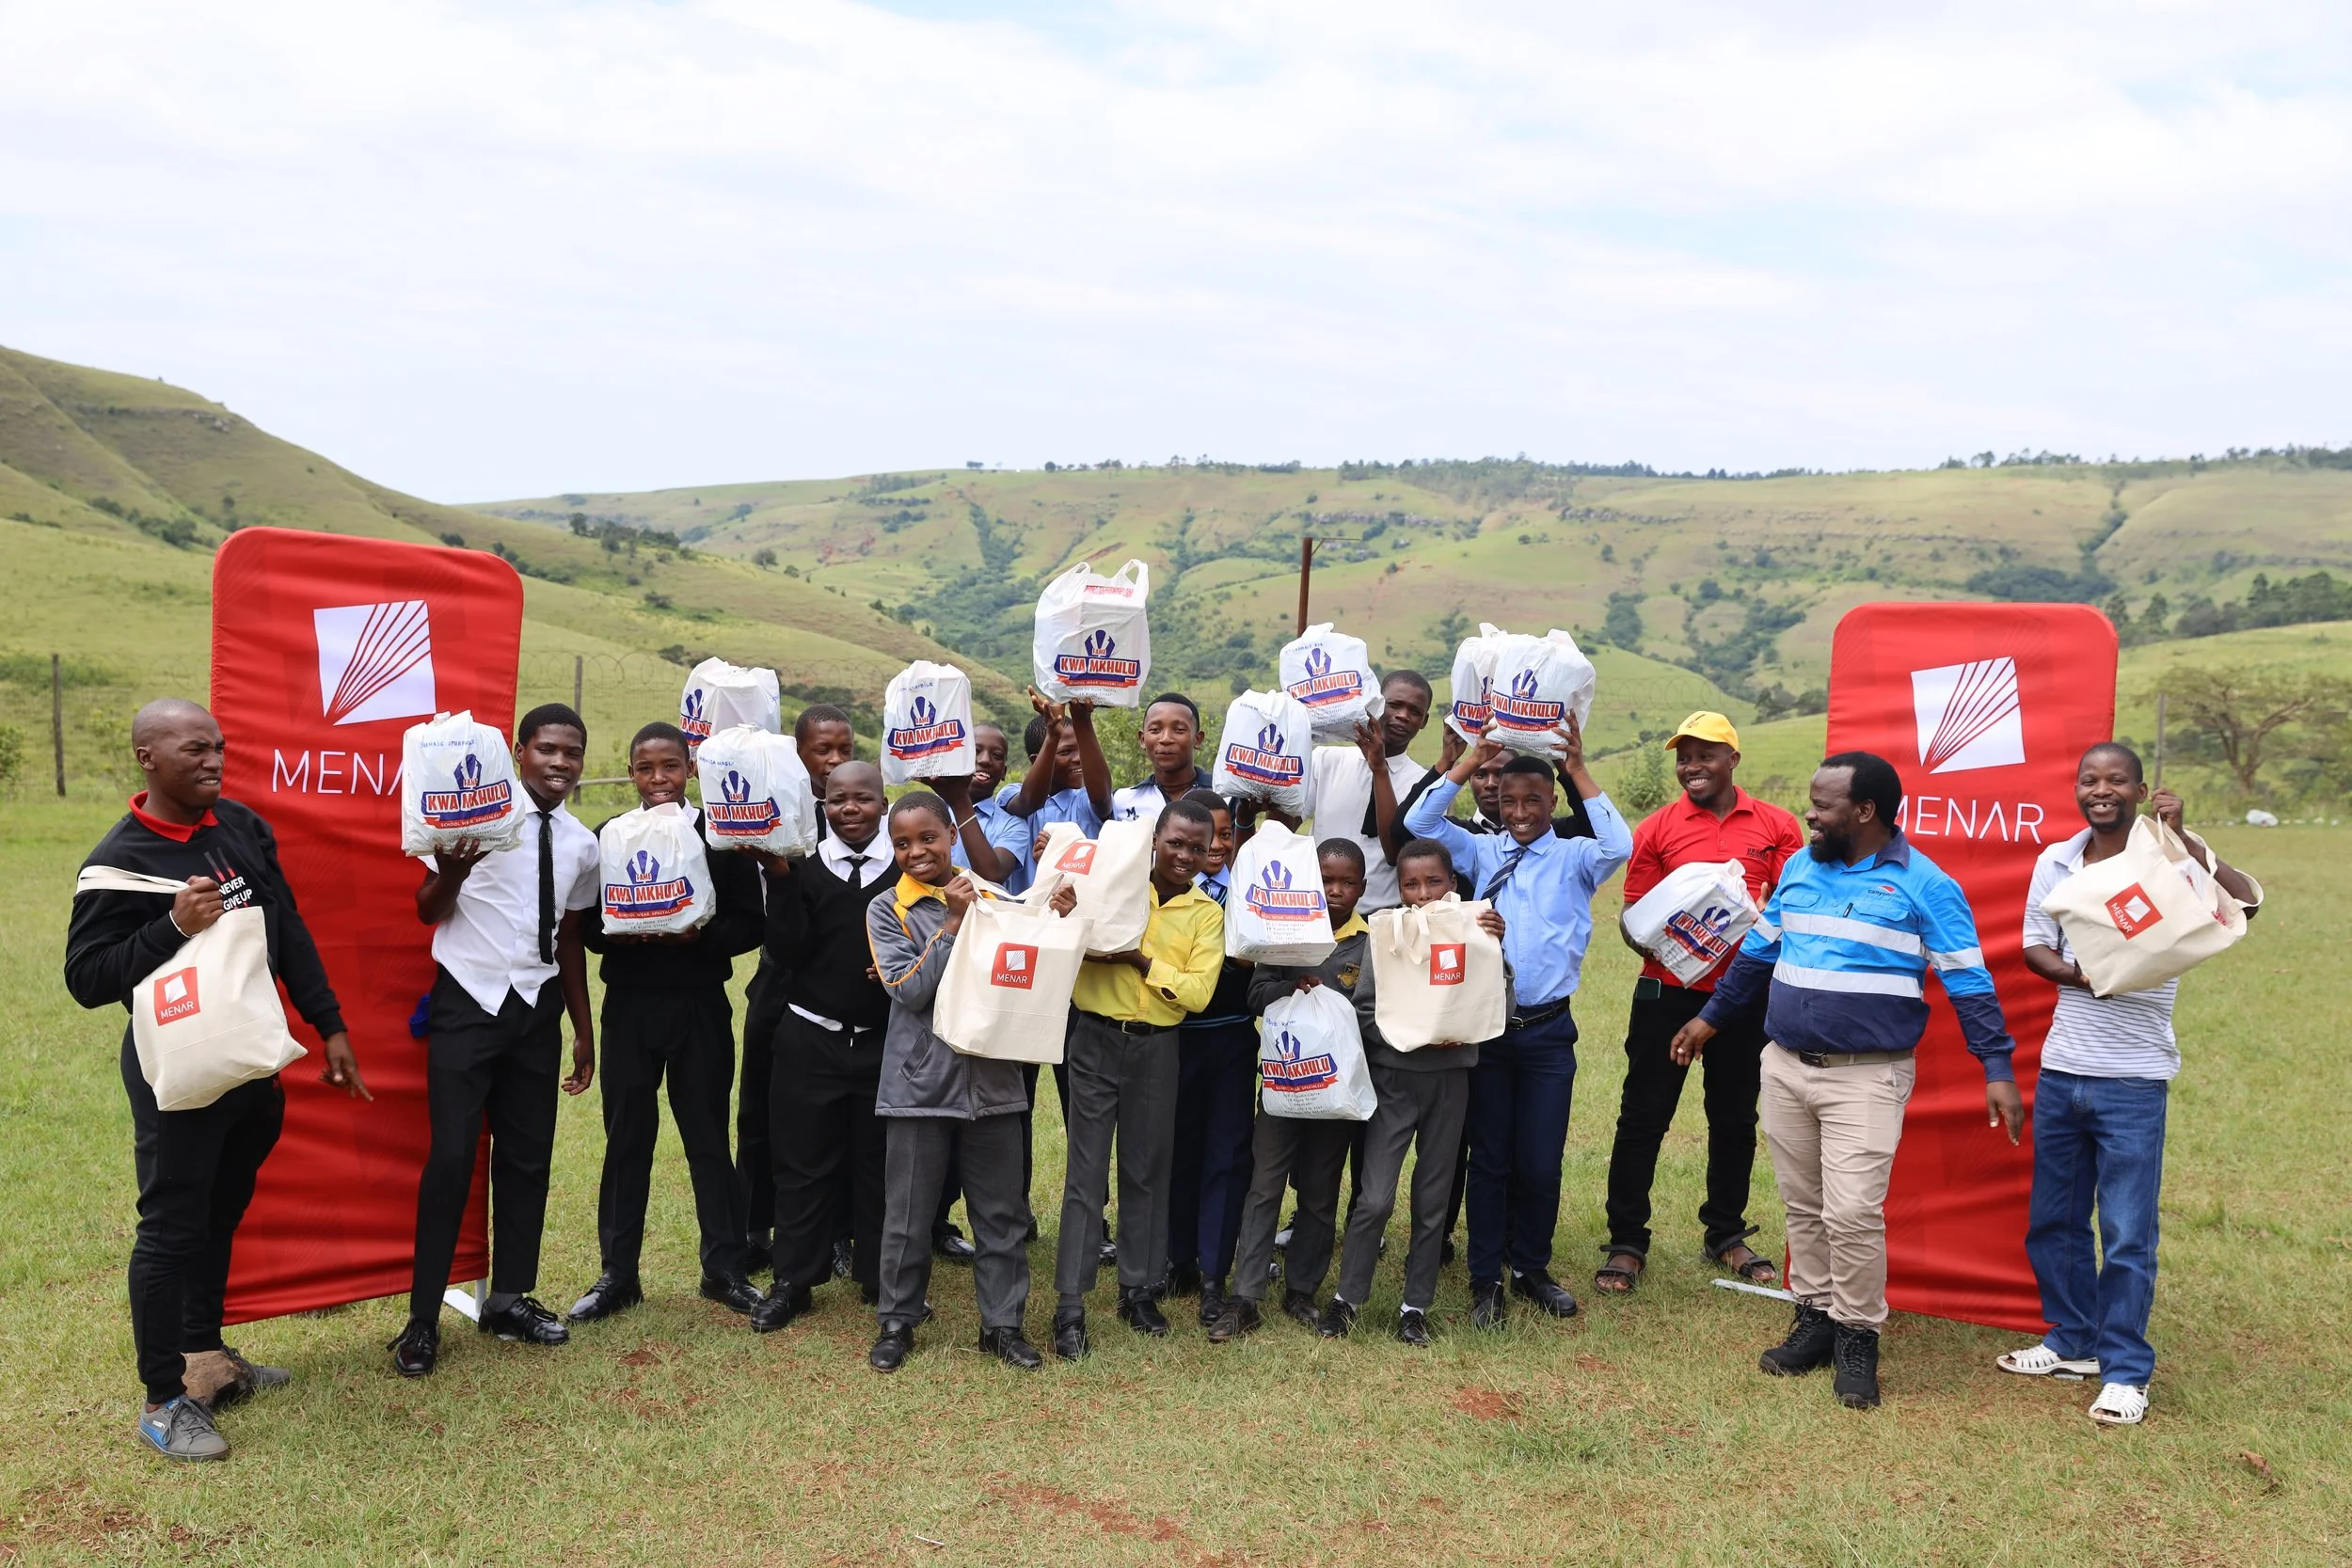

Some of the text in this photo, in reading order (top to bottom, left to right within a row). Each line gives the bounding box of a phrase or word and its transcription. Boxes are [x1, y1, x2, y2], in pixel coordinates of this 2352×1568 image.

[1060, 657, 1136, 675] KWA MKHULU
[1291, 673, 1358, 698] KWA MKHULU
[1459, 704, 1482, 720] KWA
[1491, 694, 1509, 712] KWA
[1511, 701, 1560, 718] MKHULU
[1230, 746, 1255, 765] KWA
[272, 749, 405, 796] MEN
[428, 795, 458, 811] KWA
[1061, 862, 1087, 870] MENAR
[218, 876, 246, 895] NEVER
[608, 879, 685, 903] KWA MKHULU
[223, 888, 253, 911] GIVE UP
[1271, 892, 1318, 907] MKHULU
[2111, 901, 2134, 933] MENAR
[997, 973, 1028, 984] MENAR
[1434, 973, 1461, 981] MENAR
[160, 1001, 194, 1020] MENAR
[1263, 1062, 1286, 1077] KWA
